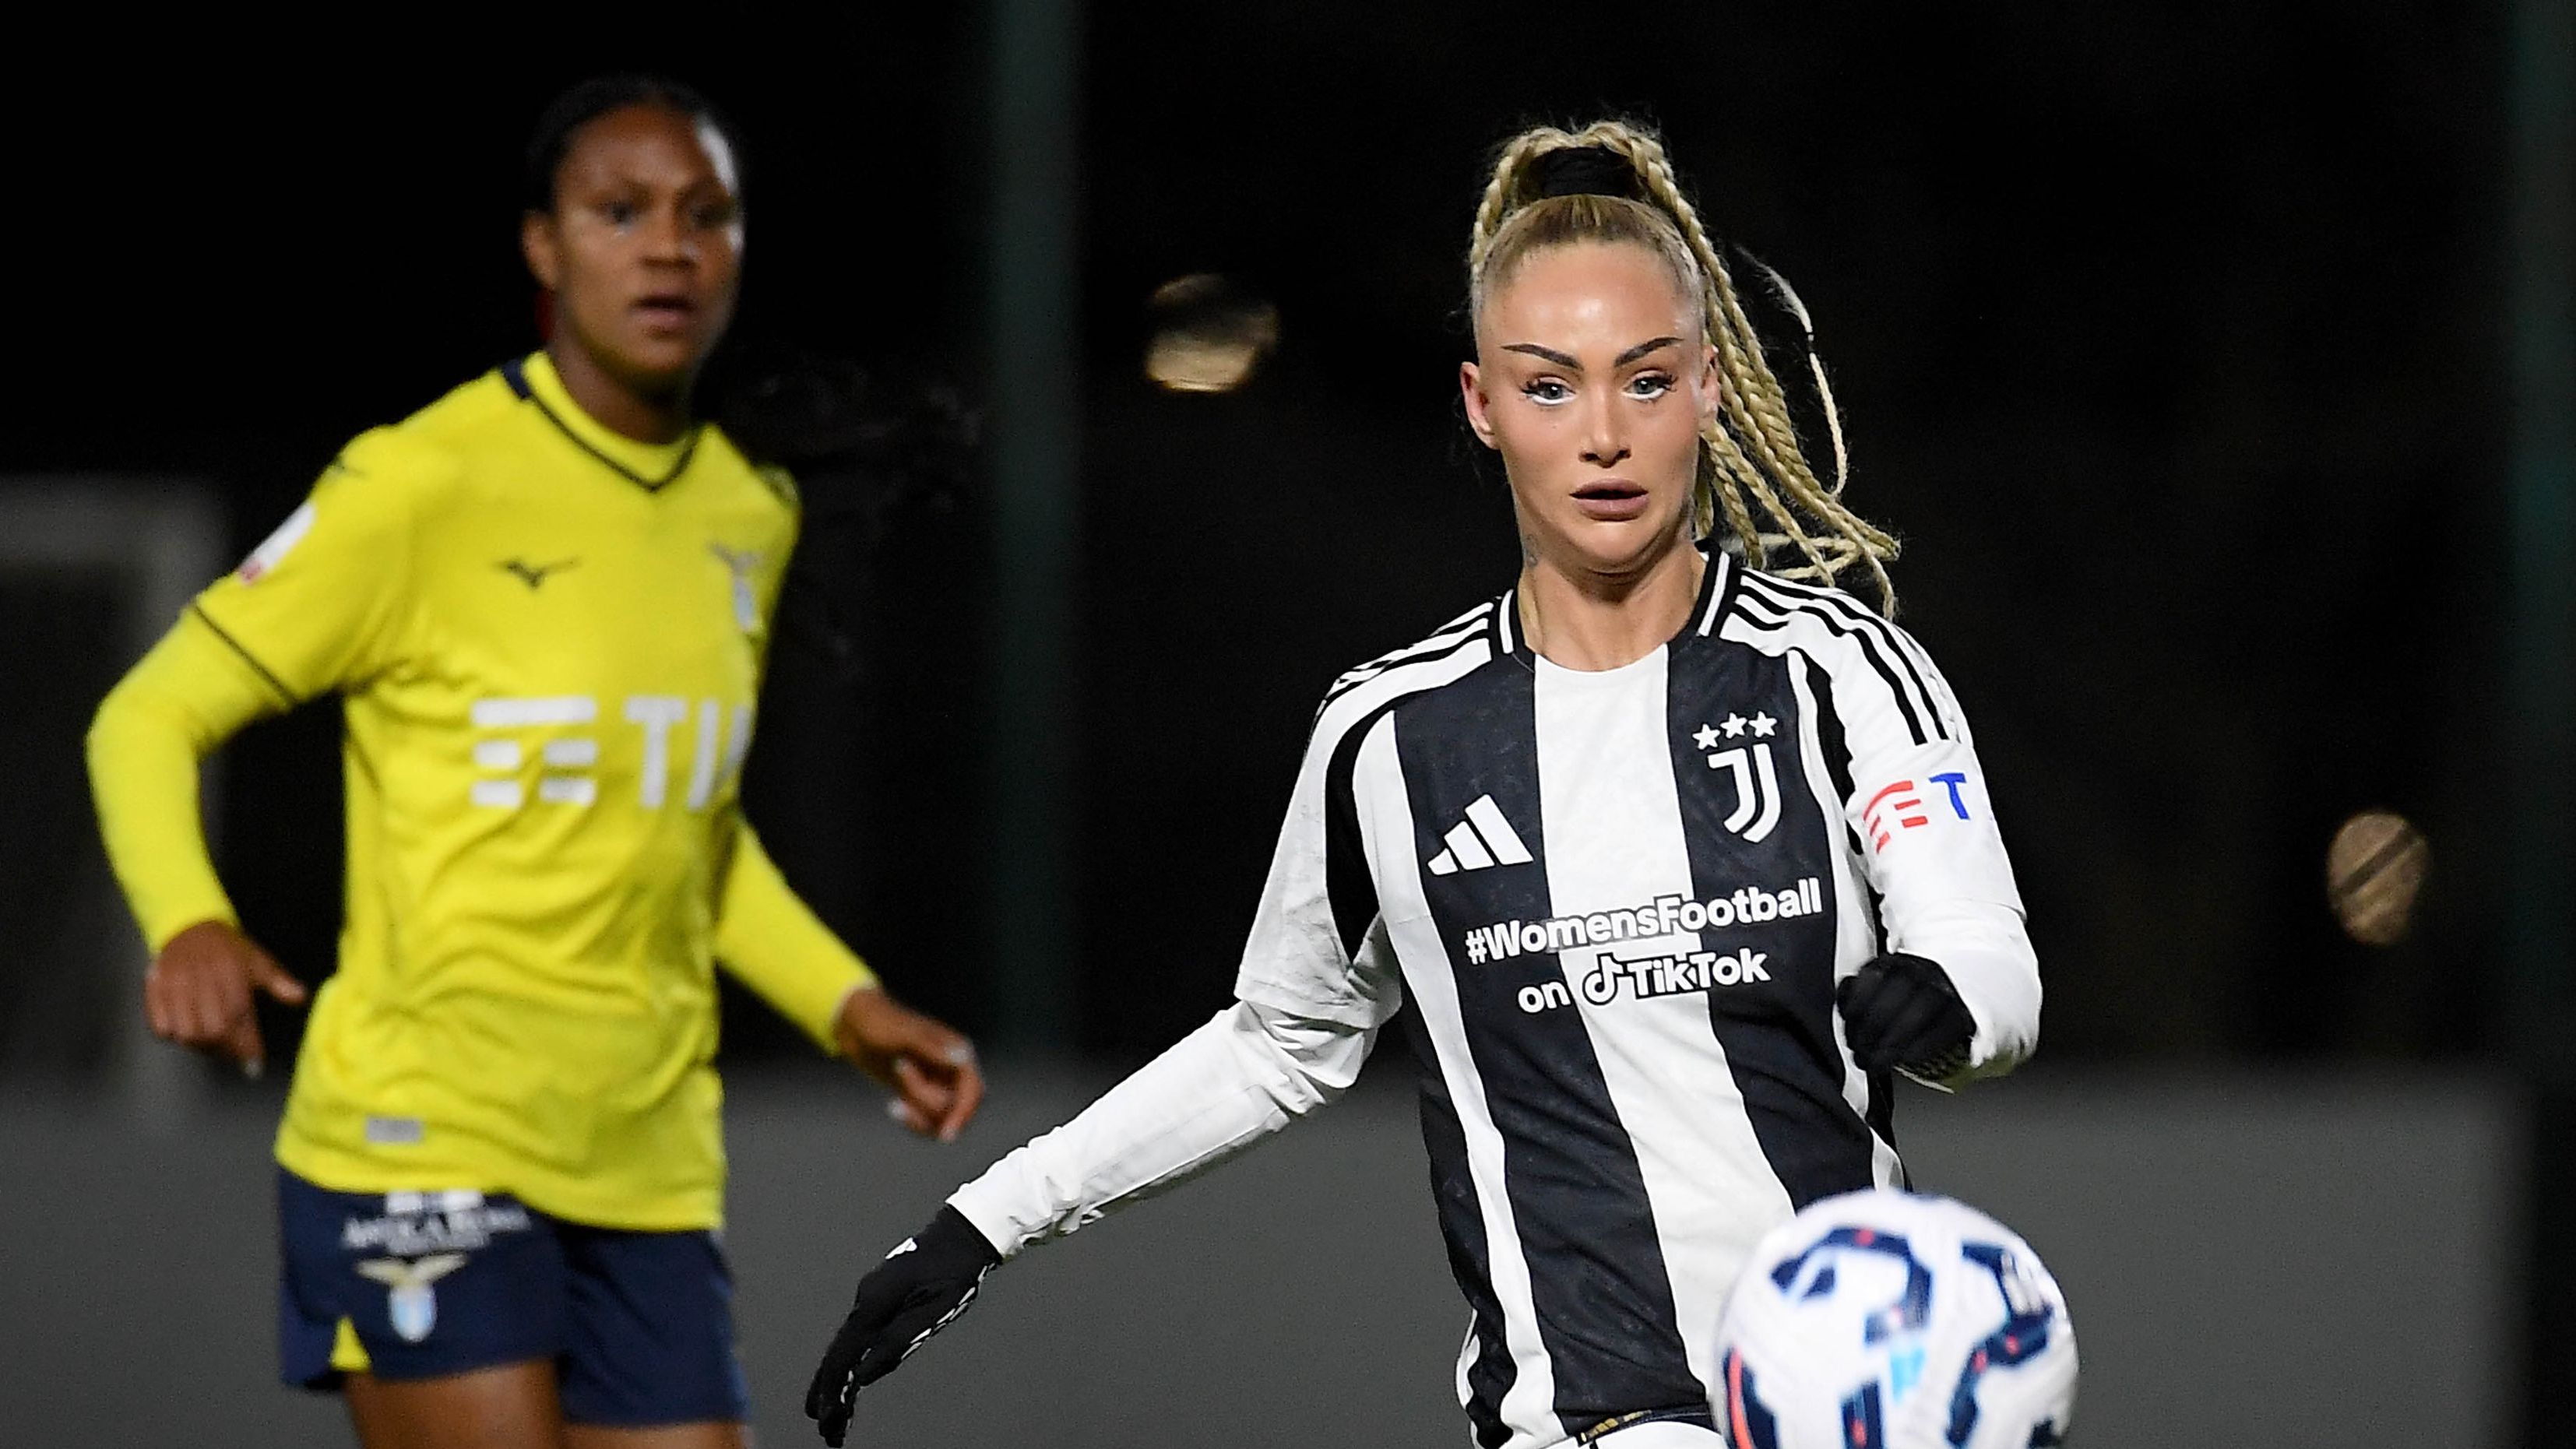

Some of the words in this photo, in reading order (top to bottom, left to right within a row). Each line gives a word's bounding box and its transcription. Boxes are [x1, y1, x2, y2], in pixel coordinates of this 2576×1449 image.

[1465, 877, 1822, 965] #WomensFootball
[1517, 981, 1571, 1013] on
[1633, 947, 1772, 997] TikTok
